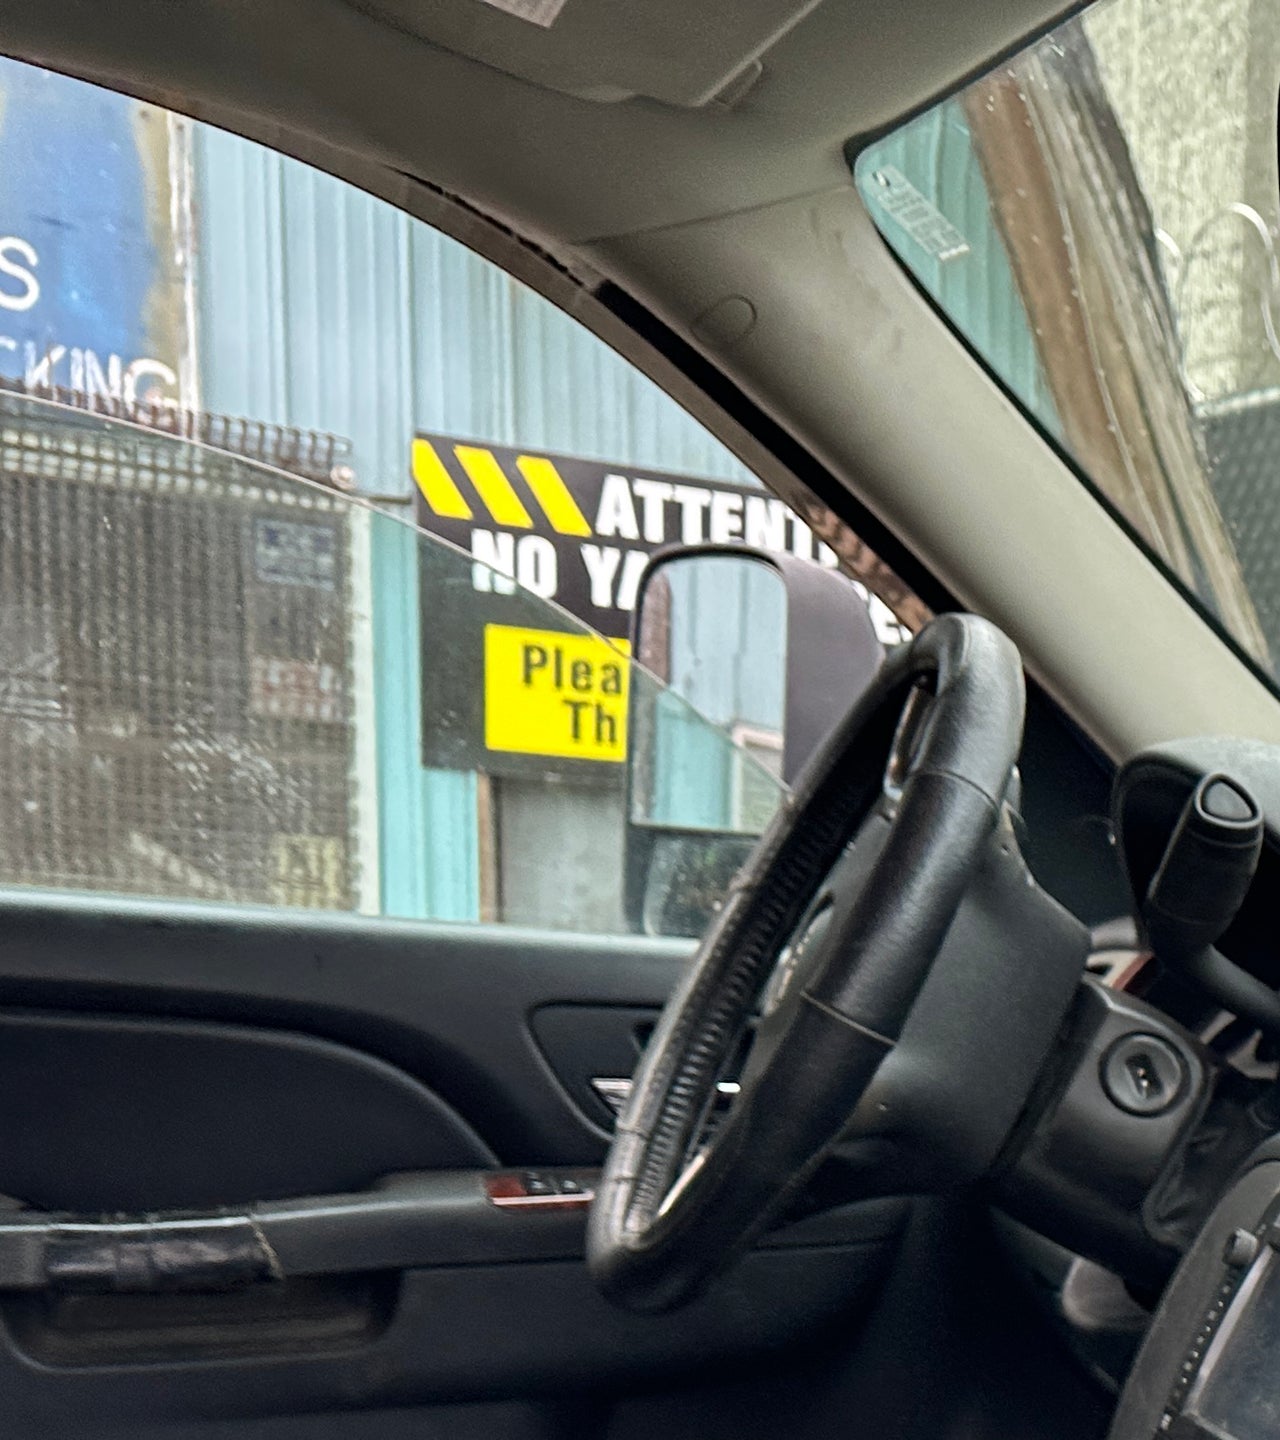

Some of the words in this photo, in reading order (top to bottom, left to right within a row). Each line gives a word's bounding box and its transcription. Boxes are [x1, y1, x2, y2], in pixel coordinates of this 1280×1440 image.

[0, 336, 178, 427] KING
[471, 528, 557, 599] NO
[523, 643, 622, 696] Plea
[562, 697, 618, 747] Th
